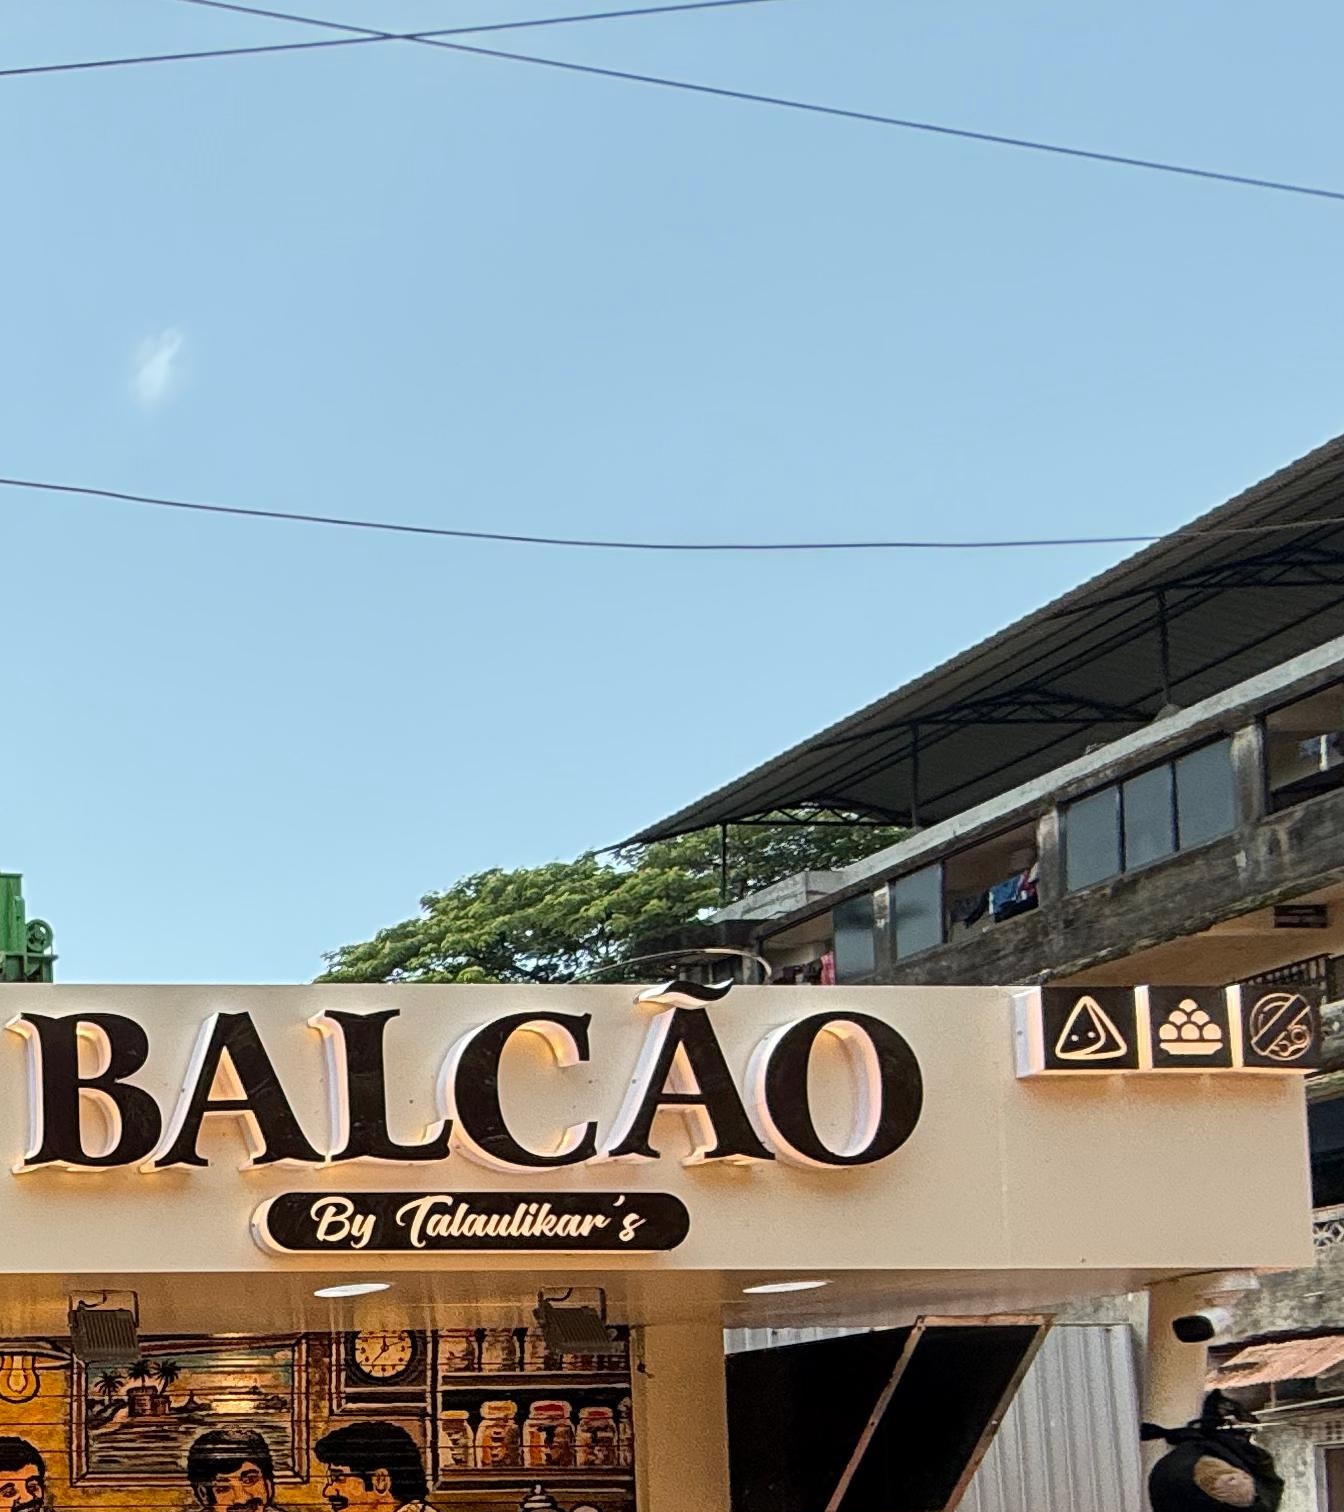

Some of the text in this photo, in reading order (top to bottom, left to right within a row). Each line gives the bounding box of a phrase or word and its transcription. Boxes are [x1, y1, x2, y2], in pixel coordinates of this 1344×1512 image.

[6, 981, 924, 1173] BALCÃO
[310, 1194, 647, 1249] By Talaulikar's
